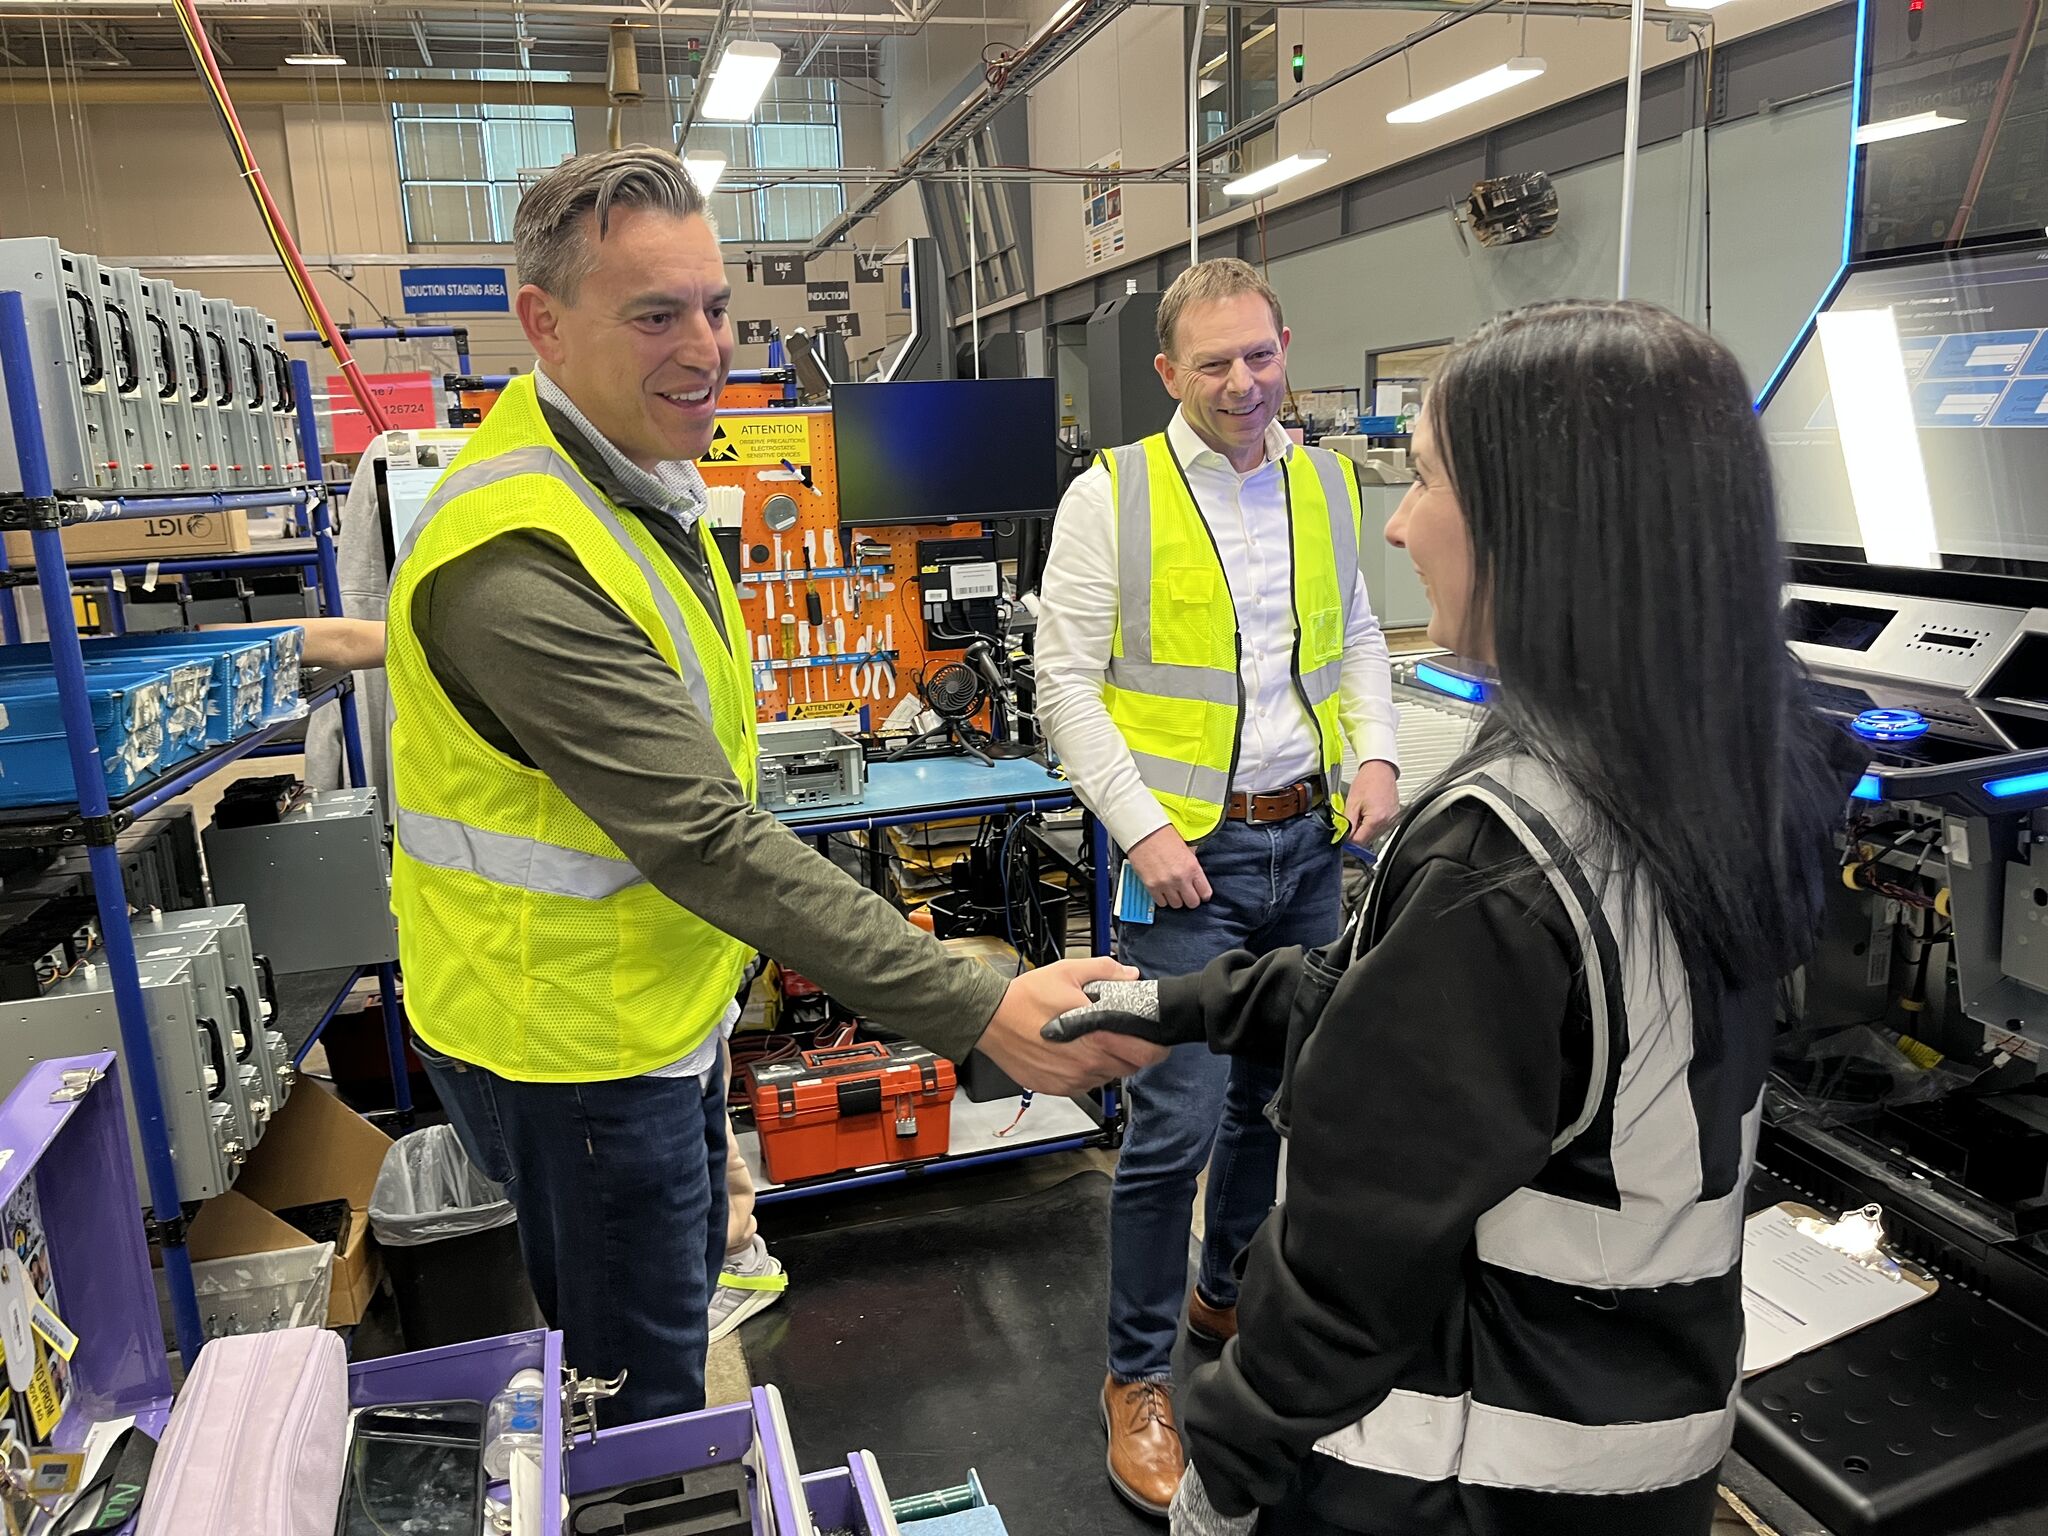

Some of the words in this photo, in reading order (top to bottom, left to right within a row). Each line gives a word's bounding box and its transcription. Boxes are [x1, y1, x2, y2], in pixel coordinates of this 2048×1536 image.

[775, 262, 792, 271] LINE
[873, 269, 878, 277] 6
[404, 285, 446, 297] INDUCTION
[447, 284, 482, 296] STAGING
[483, 284, 505, 296] AREA
[808, 291, 848, 301] INDUCTION
[388, 387, 393, 395] 7
[384, 404, 424, 415] 126724
[741, 424, 803, 435] ATTENTION
[145, 519, 182, 537] IGT
[805, 703, 845, 711] ATTENTION
[38, 1380, 55, 1418] EPROM
